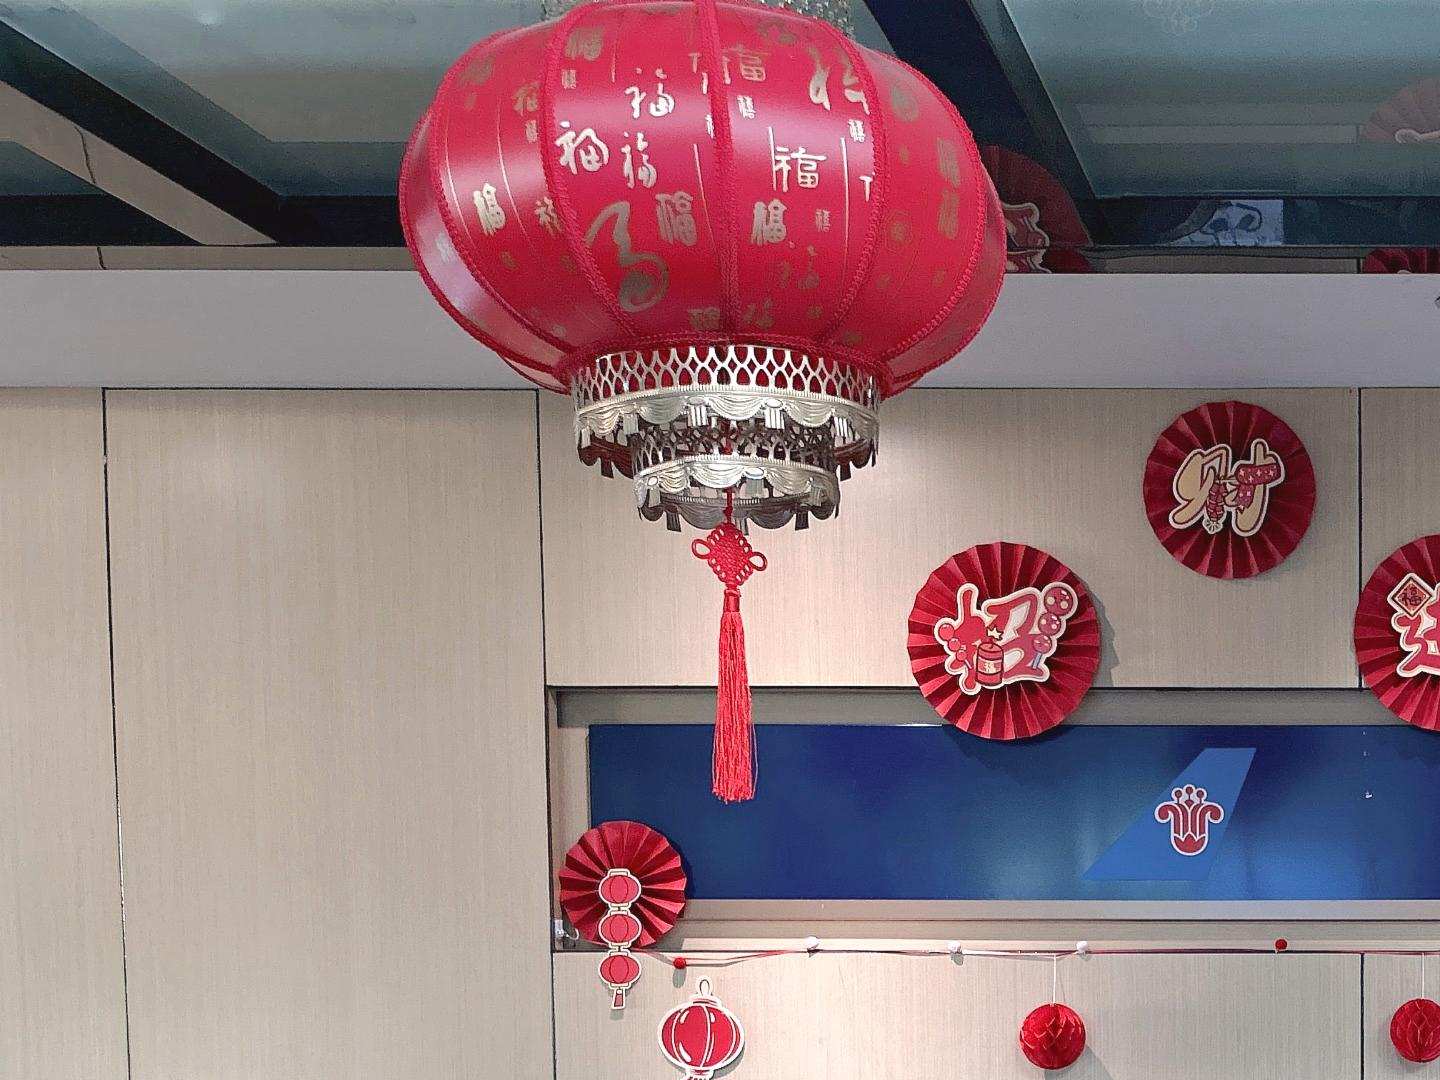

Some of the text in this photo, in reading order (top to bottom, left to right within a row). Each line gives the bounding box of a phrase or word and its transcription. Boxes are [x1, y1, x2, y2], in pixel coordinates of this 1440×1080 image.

[625, 67, 676, 118] 福
[775, 146, 827, 193] 福
[938, 584, 1058, 693] 招
